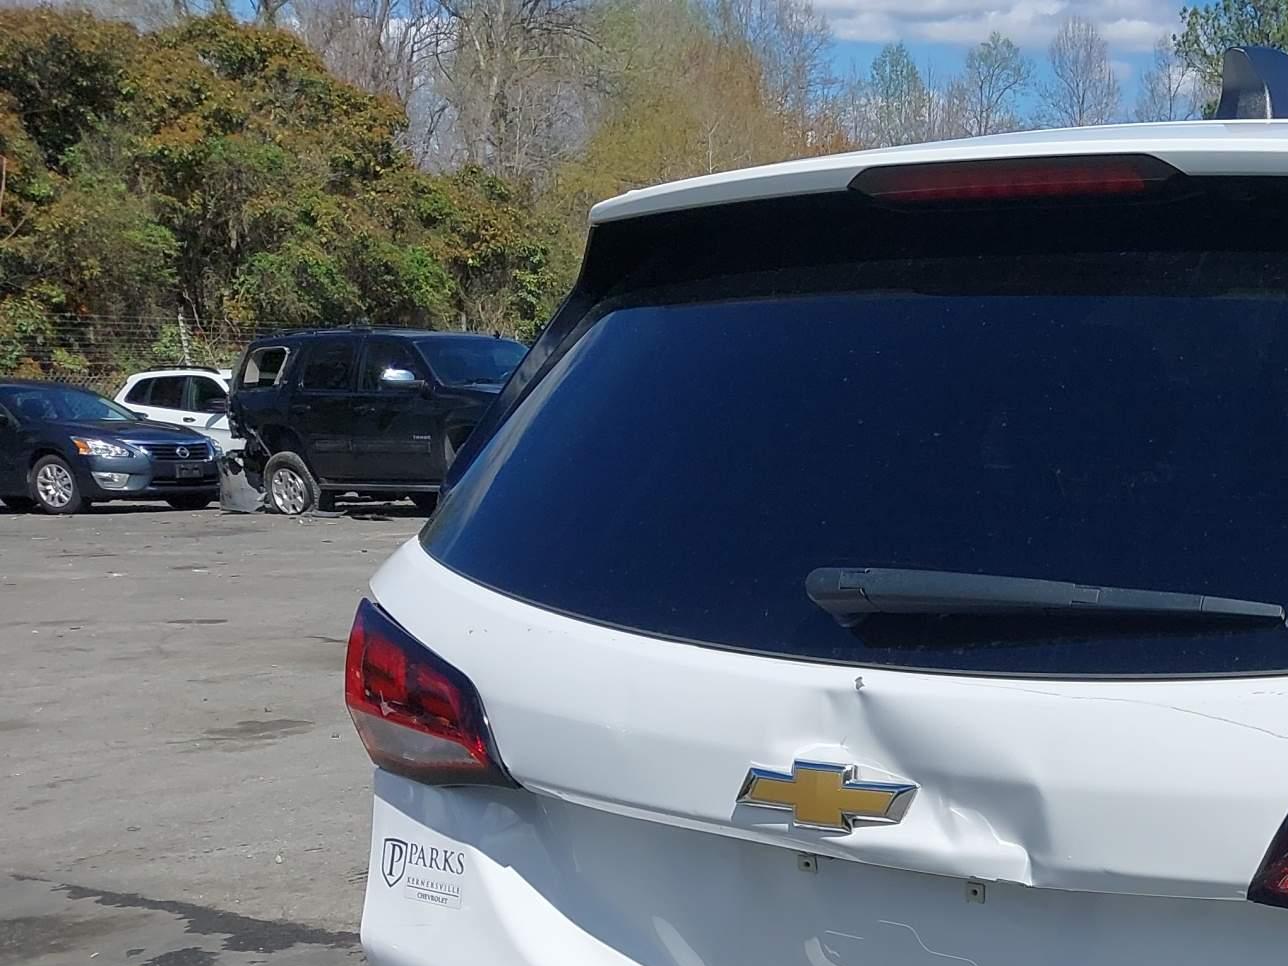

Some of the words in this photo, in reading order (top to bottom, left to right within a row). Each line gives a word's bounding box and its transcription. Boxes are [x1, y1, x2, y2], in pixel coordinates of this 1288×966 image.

[408, 843, 465, 875] PARKS
[407, 877, 460, 894] KERNERSVILLE
[417, 892, 449, 904] CHEVROLET
